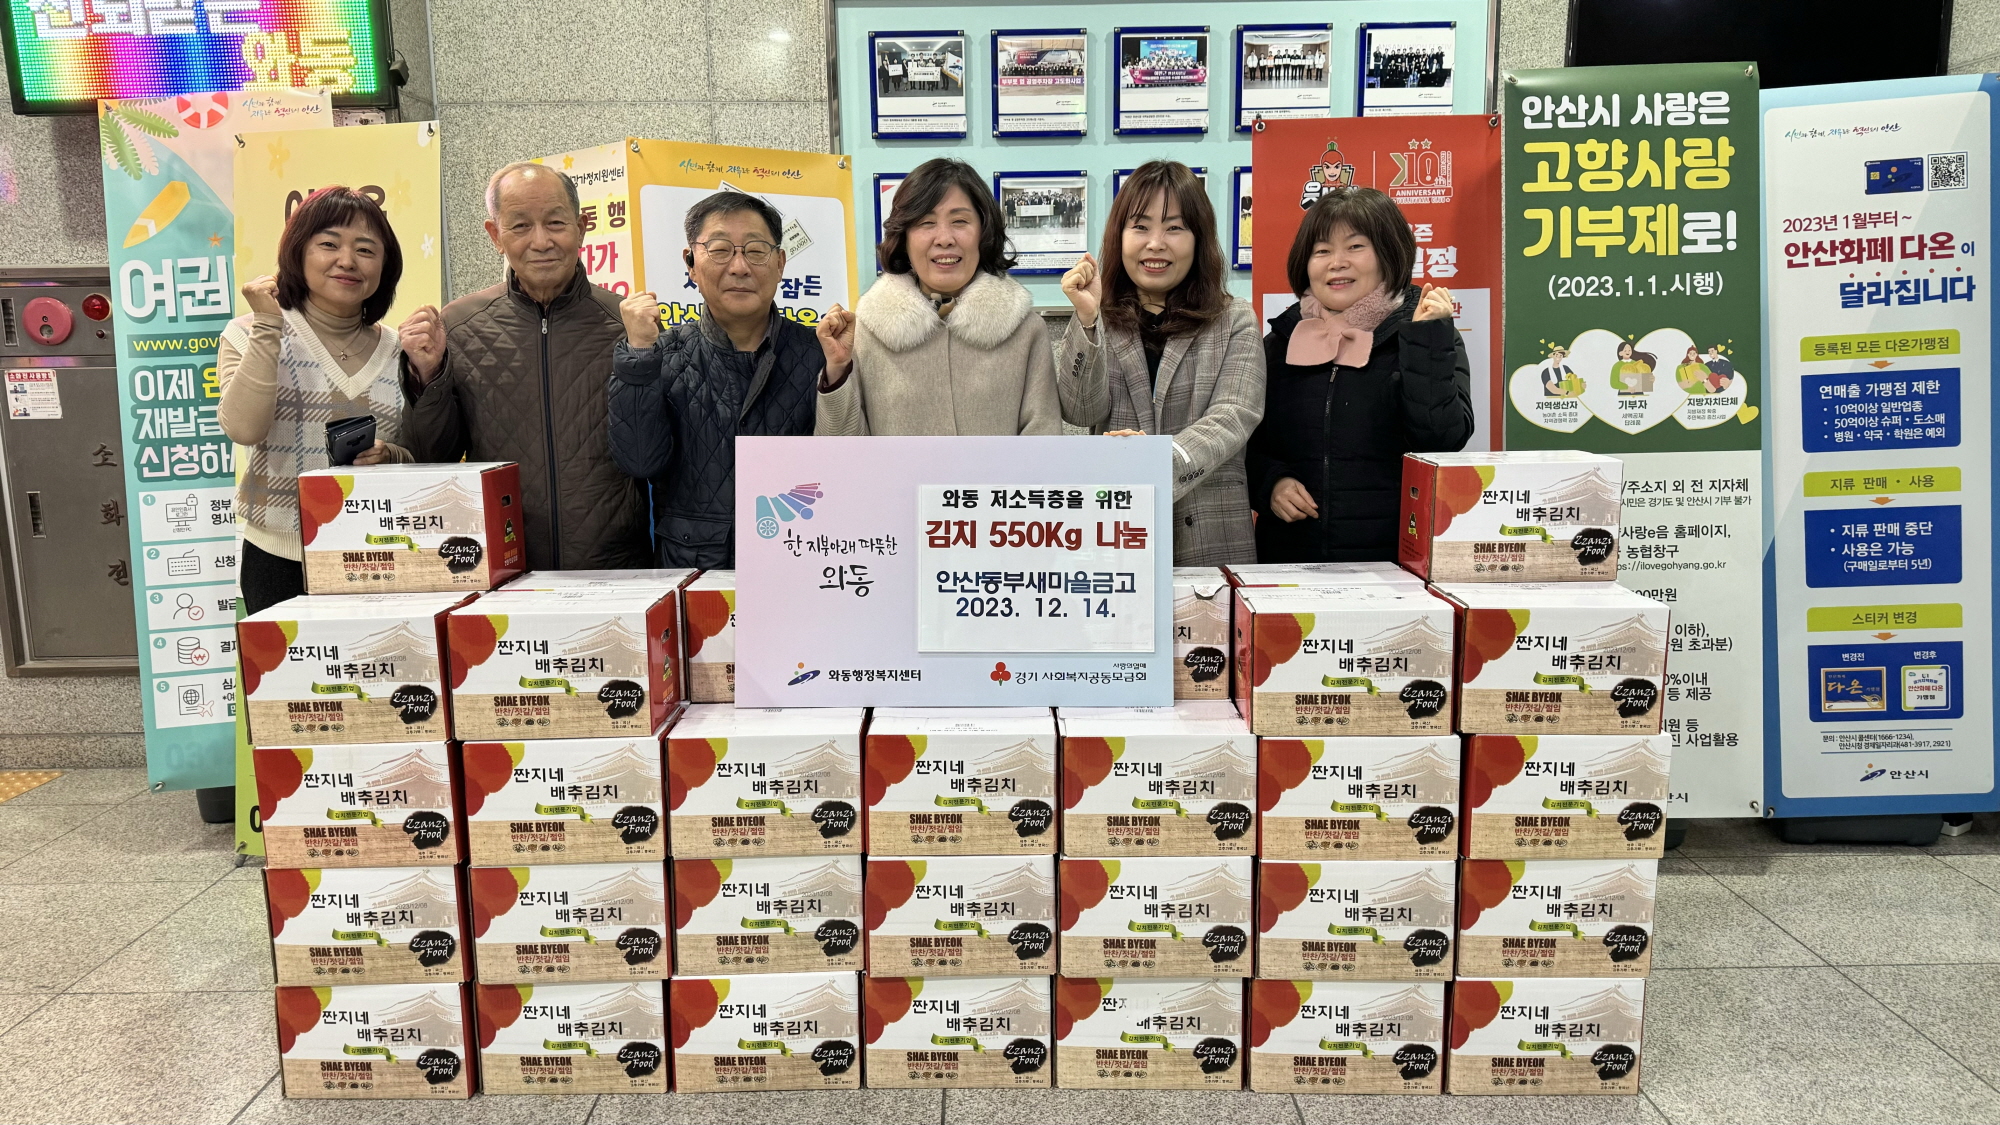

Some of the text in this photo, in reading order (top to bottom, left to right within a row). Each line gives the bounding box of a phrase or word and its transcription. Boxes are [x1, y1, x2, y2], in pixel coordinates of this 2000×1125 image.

[241, 28, 357, 95] 와동
[1522, 91, 1731, 130] 안산시 사랑은
[1880, 123, 1903, 132] 안산
[1522, 136, 1736, 192] 고향사랑
[570, 165, 625, 188] 강가정지원센터
[781, 169, 804, 180] 안산
[1395, 188, 1446, 197] ANNIVERSARY
[607, 200, 626, 229] 행
[1783, 210, 1899, 234] 2023년 1월부터
[1522, 203, 1737, 258] 기부제로!
[1785, 231, 1975, 269] 안산화폐 다온 이
[119, 255, 235, 318] 여권
[780, 275, 823, 300] 잠든
[1548, 271, 1724, 300] (2023.1.1.시행)
[1839, 274, 1976, 309] 달라집니다
[1814, 336, 1949, 357] 등록된 모든 다온가맹점
[134, 367, 195, 402] 이제
[1819, 379, 1940, 399] 연매출 가맹점 제한
[1535, 400, 1579, 410] 지역생산자
[1618, 400, 1647, 410] 기부자
[1687, 397, 1738, 407] 지방자치단체
[1834, 401, 1923, 415] 10억이상 일반업종
[136, 405, 226, 440] 재발급
[1834, 413, 1946, 428] 50억이상 슈퍼 도소매
[1834, 427, 1946, 442] 병원 약국 학원은 예외
[1672, 479, 1685, 494] 외
[1690, 478, 1704, 493] 전
[1709, 478, 1749, 493] 지자체
[1830, 475, 1936, 491] 지류 판매 사용
[146, 496, 152, 504] 1
[210, 499, 231, 512] 정부
[344, 498, 392, 514] 짠지네
[941, 489, 1133, 509] 와동 저소득층을 위한
[1648, 496, 1674, 507] 경기도
[1675, 496, 1685, 507] 및
[1686, 496, 1712, 507] 안산시
[1714, 495, 1732, 506] 기부
[1733, 495, 1752, 506] 불가
[211, 512, 236, 526] 영사
[379, 514, 444, 531] 배추김치
[925, 520, 1149, 551] 김치 550Kg 나눔
[1619, 523, 1731, 539] 사랑e음 홈페이지,
[1841, 521, 1934, 538] 지류 판매 중단
[441, 542, 481, 554] Zzanzi
[783, 528, 898, 557] 한 지붕아래 따뜻한
[1841, 541, 1914, 558] 사용은 가능
[150, 550, 156, 558] 2
[342, 551, 395, 563] SHAE BYEOK
[1626, 544, 1680, 559] 농협창구
[214, 555, 236, 568] 신청
[343, 562, 395, 571] 반찬/젓갈/절임
[454, 553, 476, 566] Food
[1844, 558, 1932, 573] (구매일로부터 5년)
[819, 564, 875, 597] 와동
[936, 570, 1137, 594] 안산동부새마을금고
[153, 594, 159, 602] 3
[956, 597, 1116, 618] 2023. 12. 14.
[1852, 611, 1918, 626] 스티커 변경
[1675, 623, 1710, 638] 이하),
[1688, 636, 1733, 652] 초과분)
[1842, 652, 1865, 661] 변경전
[1914, 650, 1937, 660] 변경후
[1112, 662, 1147, 670] 사랑의열매
[828, 667, 922, 683] 와동행정복지센터
[1015, 669, 1147, 685] 경기 사회복지공동모금회
[1827, 678, 1863, 695] 다온
[1667, 687, 1712, 702] 등 제공
[1686, 718, 1700, 733] 등
[1686, 732, 1739, 747] 사업활용
[1838, 734, 1857, 742] 안산시
[1932, 740, 1952, 748] 2921)
[915, 760, 964, 775] 짠지네
[1889, 769, 1929, 780] 안산시
[950, 777, 1017, 793] 배추김치
[910, 813, 962, 824] SHAE BYEOK
[1012, 805, 1052, 819] Zzanzi
[910, 824, 963, 834] 반찬/젓갈/절임
[1025, 817, 1047, 830] Food
[1500, 1004, 1549, 1020] 짠지네
[1535, 1022, 1601, 1038] 배추김치
[1491, 1057, 1545, 1068] SHAE BYEOK
[1594, 1051, 1634, 1063] Zzanzi
[1491, 1067, 1544, 1077] 반찬/젓갈/절임
[1606, 1061, 1628, 1073] Food
